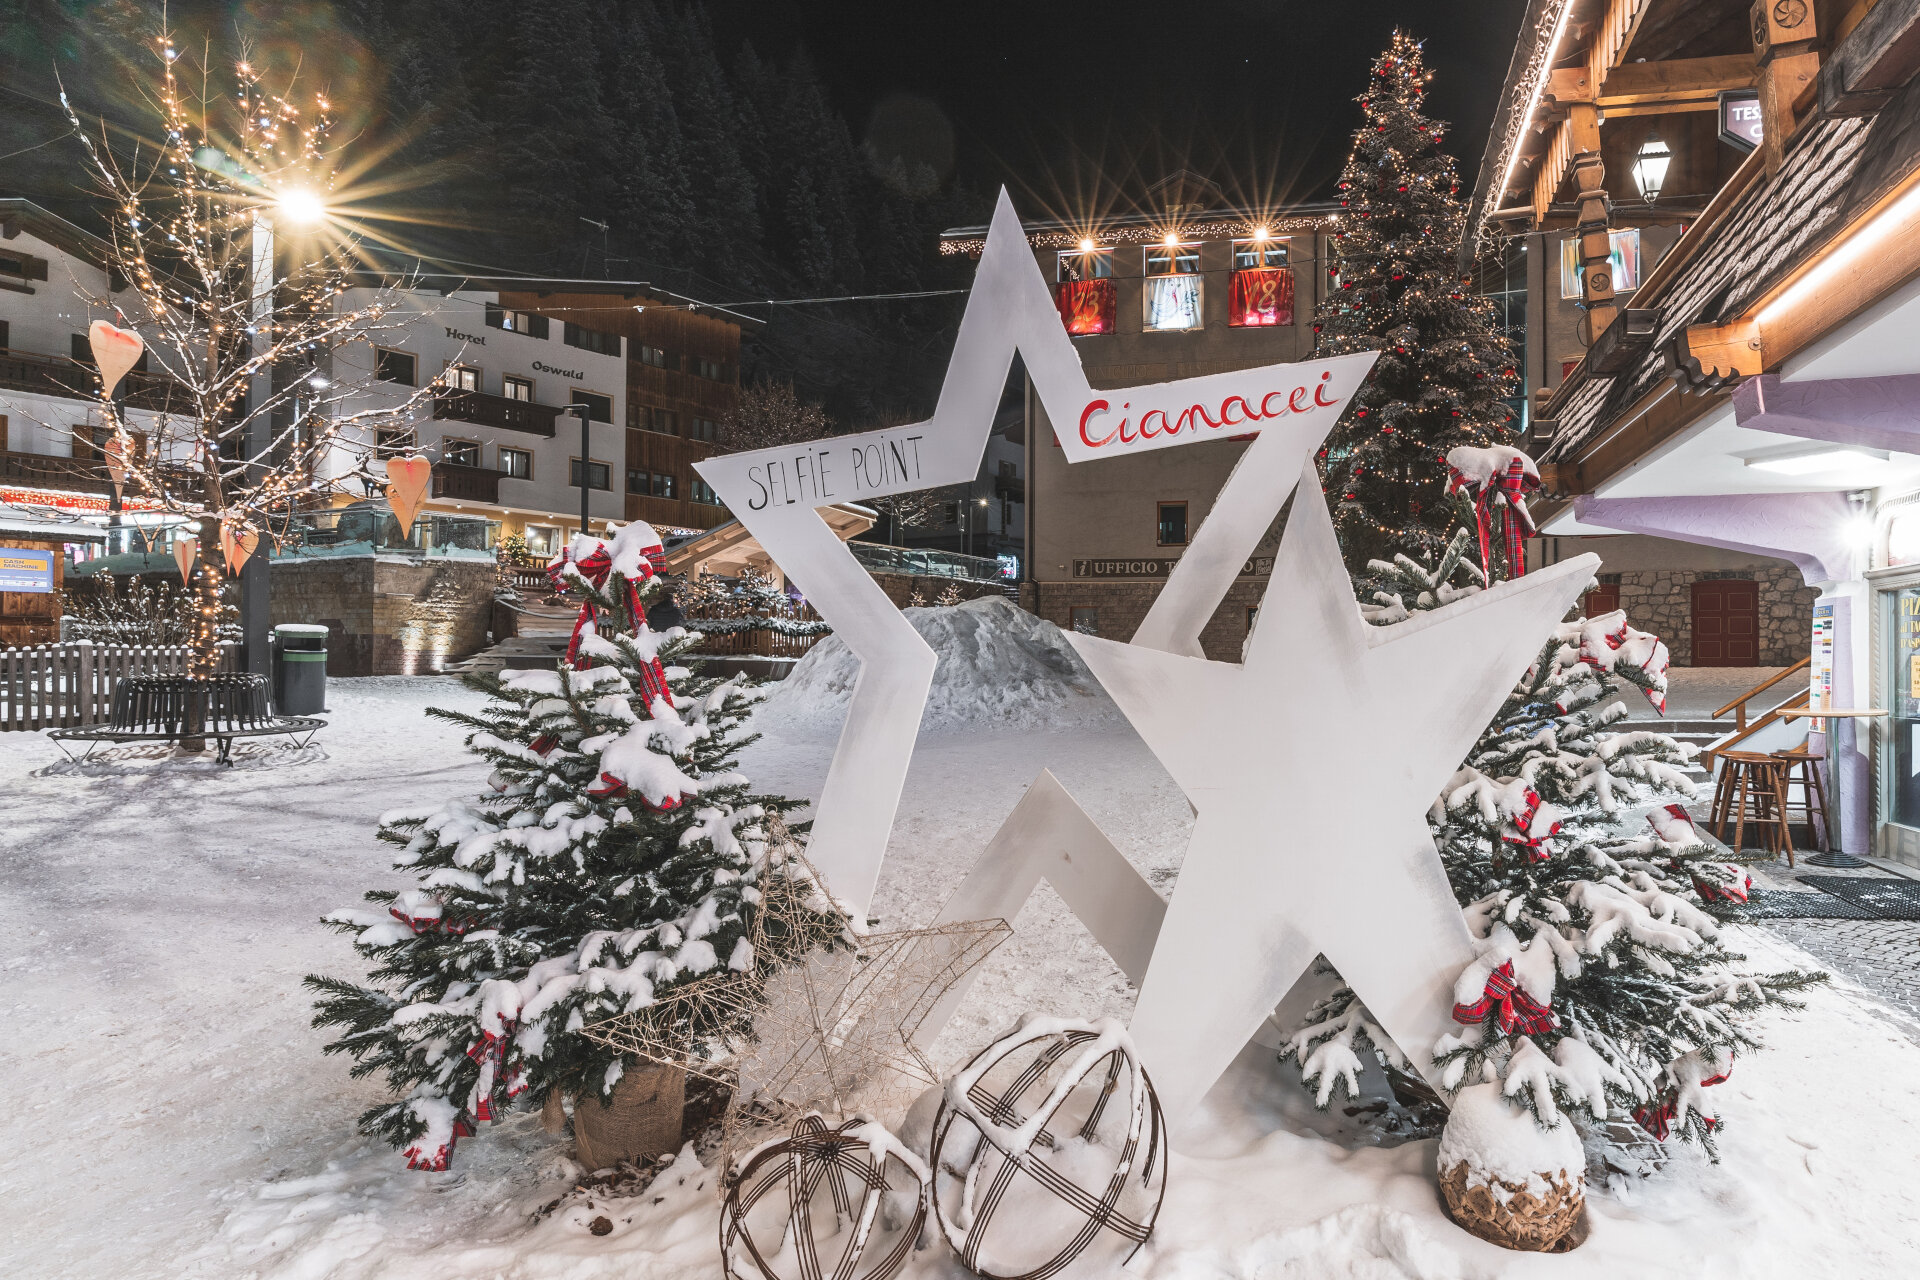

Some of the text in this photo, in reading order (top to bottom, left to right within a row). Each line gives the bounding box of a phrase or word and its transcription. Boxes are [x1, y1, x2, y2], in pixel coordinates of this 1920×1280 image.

[1068, 289, 1100, 323] 23
[1245, 279, 1277, 314] 18
[444, 326, 487, 346] Hotel
[531, 360, 585, 381] Oswald
[1079, 371, 1342, 448] Cianacei
[1093, 561, 1158, 575] UFFICIO
